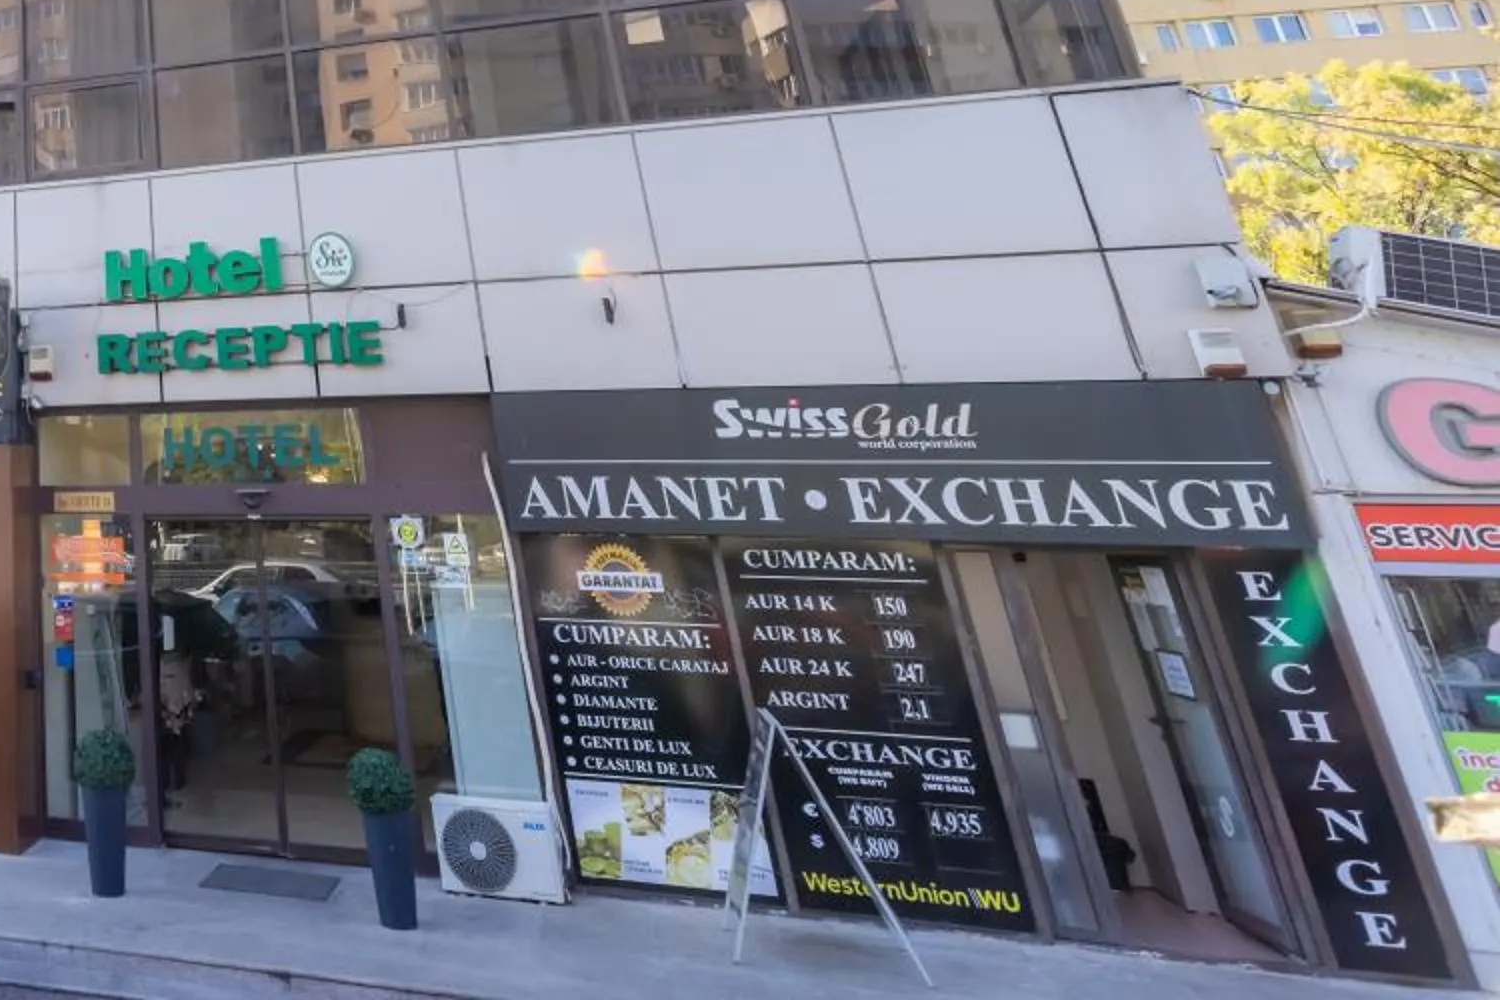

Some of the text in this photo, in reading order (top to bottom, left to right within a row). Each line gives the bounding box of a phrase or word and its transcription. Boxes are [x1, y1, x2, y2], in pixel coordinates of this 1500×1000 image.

[105, 237, 283, 301] Hotel
[97, 321, 384, 374] RECEPTIE
[163, 423, 340, 470] HOTEL
[857, 438, 977, 452] world corporation
[520, 475, 1290, 532] AMANET EXCHANGE
[581, 574, 658, 589] GARANTAT
[745, 594, 907, 616] AUR 14 K 150
[753, 626, 916, 649] AUR 18 K 190
[567, 654, 597, 667] AUR
[609, 655, 657, 671] ORICE
[659, 658, 729, 674] CARATAJ
[759, 657, 925, 683] AUR 24 K 247
[570, 675, 629, 689] ARGINT
[573, 694, 658, 711] DIAMANTE
[767, 690, 850, 711] ARGINT
[577, 714, 655, 731] BIJUTERII
[580, 735, 692, 756] GENTI DE LUX
[583, 756, 717, 779] CEASURI DE LUX
[1236, 571, 1407, 950] EXCHANGE
